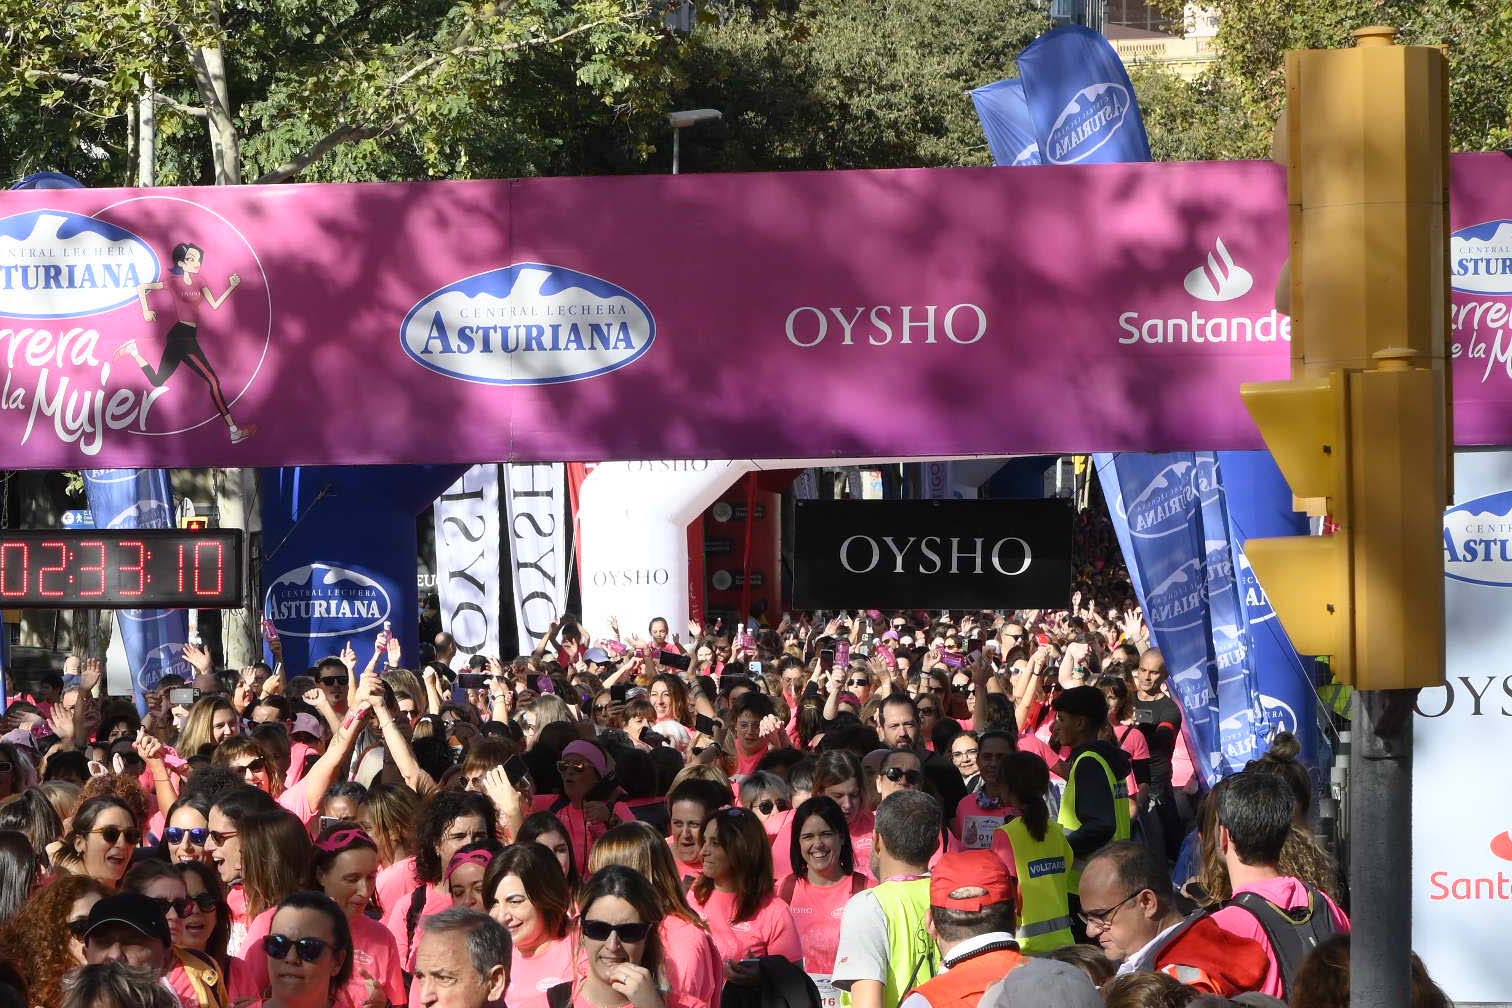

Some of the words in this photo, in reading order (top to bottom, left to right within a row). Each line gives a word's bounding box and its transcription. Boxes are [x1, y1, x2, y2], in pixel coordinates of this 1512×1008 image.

[63, 245, 135, 257] LECHERA
[1451, 257, 1512, 276] STUR
[460, 305, 539, 318] CENTRAL
[547, 304, 627, 316] LECHERA
[420, 311, 635, 354] ASTURIANA
[785, 303, 988, 348] OYSHO
[1119, 311, 1291, 345] Santande
[1469, 331, 1486, 358] la
[1, 365, 26, 410] la
[21, 364, 172, 455] Mujer
[0, 540, 223, 597] 02:33:10
[839, 534, 1032, 576] OYSHO
[593, 568, 669, 587] OYSHO
[328, 589, 376, 597] LECHERA
[269, 594, 381, 621] ASTURIANA
